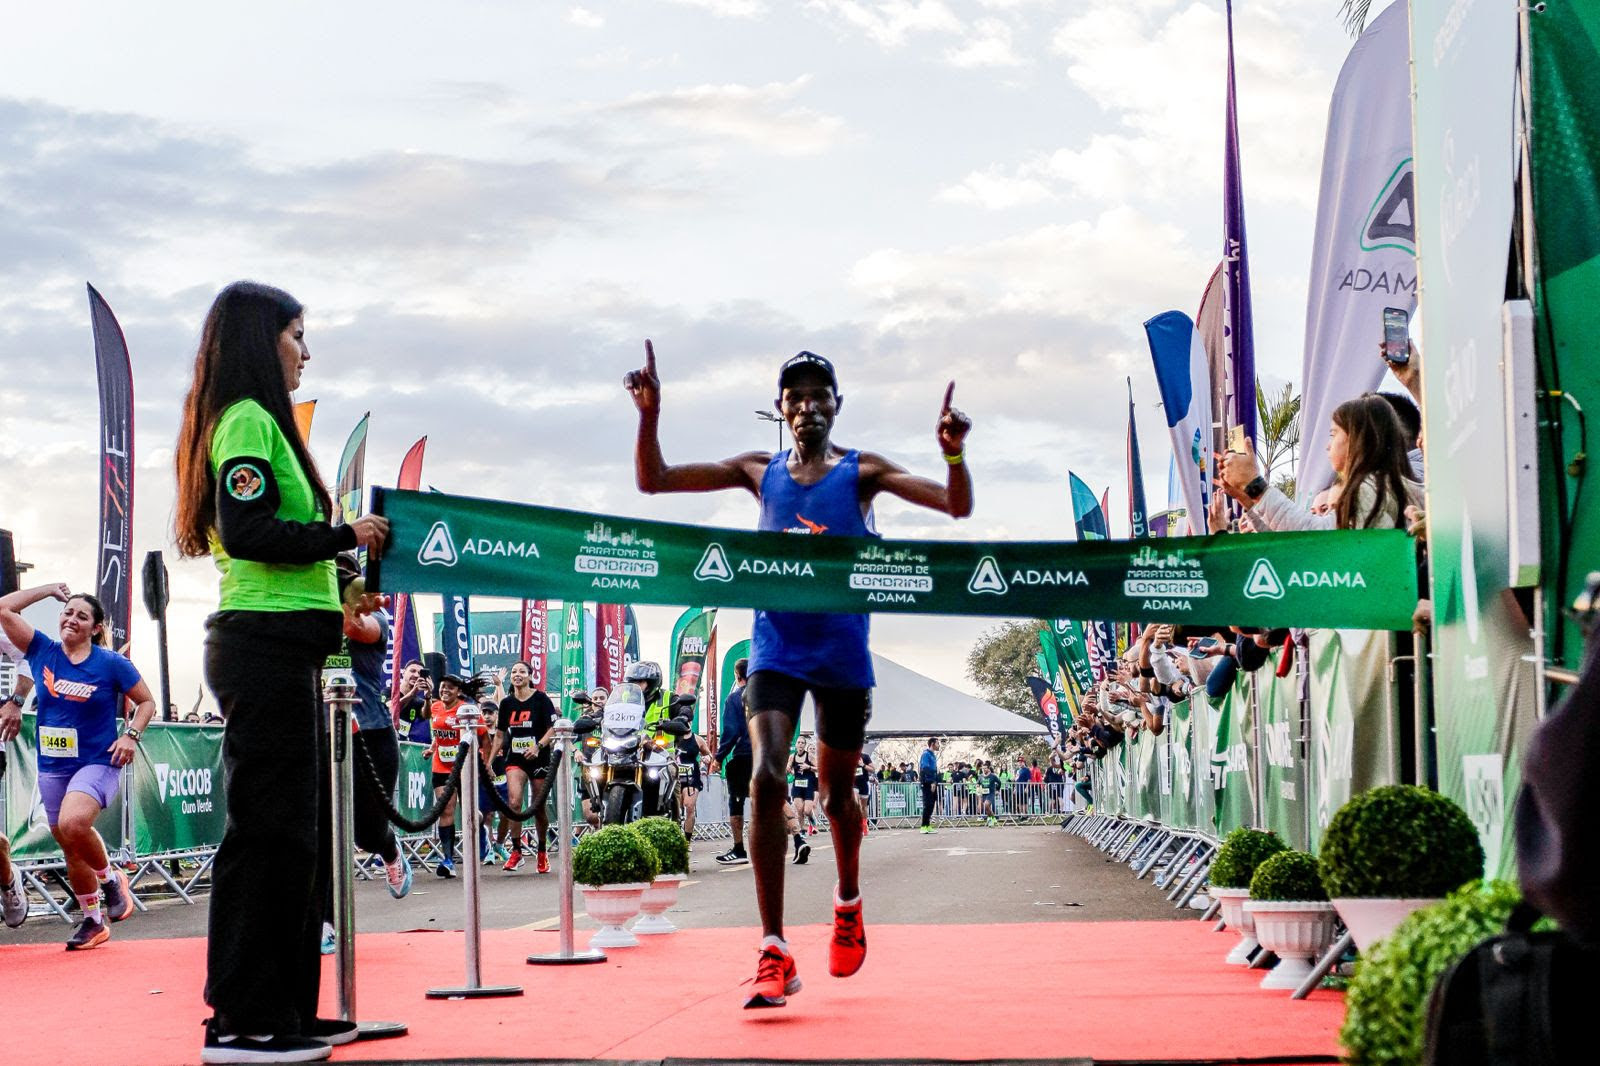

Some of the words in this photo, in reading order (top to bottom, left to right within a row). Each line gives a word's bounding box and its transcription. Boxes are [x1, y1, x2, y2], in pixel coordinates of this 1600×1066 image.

[1338, 268, 1417, 297] ADAM
[461, 538, 540, 559] ADAMA
[579, 545, 639, 558] MARATONA
[642, 550, 656, 559] DE
[578, 559, 656, 573] LONDRINA
[737, 559, 815, 577] ADAMA
[853, 563, 913, 574] MARATONA
[915, 565, 929, 575] DE
[1011, 569, 1089, 585] ADAMA
[1127, 570, 1187, 579] MARATONA
[1190, 570, 1204, 579] DE
[1287, 571, 1367, 588] ADAMA
[591, 577, 641, 590] ADAMA
[853, 576, 929, 589] LONDRINA
[1127, 582, 1205, 595] LONDRINA
[867, 592, 916, 603] ADAMA
[1142, 599, 1192, 611] ADAMA
[609, 712, 636, 722] 42km
[169, 767, 212, 798] SICOOB
[408, 771, 426, 810] RPC
[182, 801, 196, 814] Ouro
[196, 798, 212, 813] Verde
